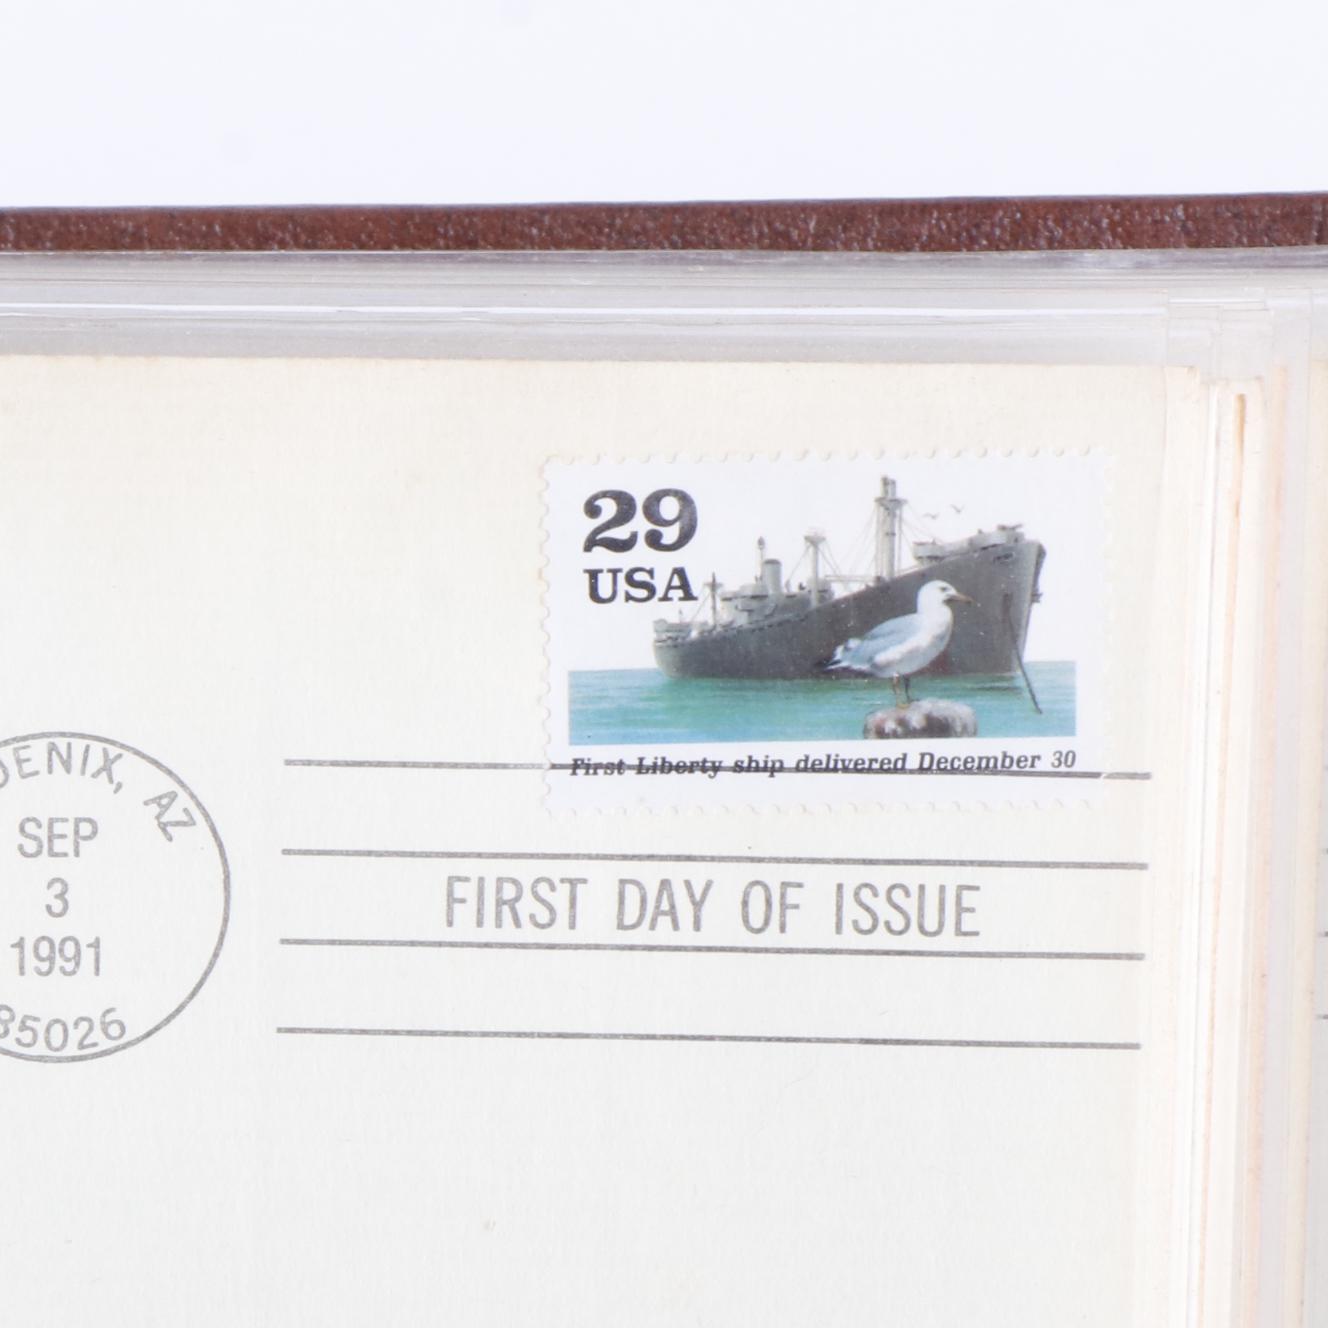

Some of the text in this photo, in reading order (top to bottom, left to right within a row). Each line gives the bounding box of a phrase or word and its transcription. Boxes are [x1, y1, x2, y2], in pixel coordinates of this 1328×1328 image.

[583, 488, 698, 553] 29
[583, 566, 699, 604] USA
[569, 750, 1077, 779] First Liberty ship delivered December 30
[17, 816, 99, 858] SEP
[142, 790, 197, 842] AZ
[45, 877, 70, 918] 3
[445, 875, 981, 937] FIRST DAY OF ISSUE
[10, 935, 101, 977] 1991
